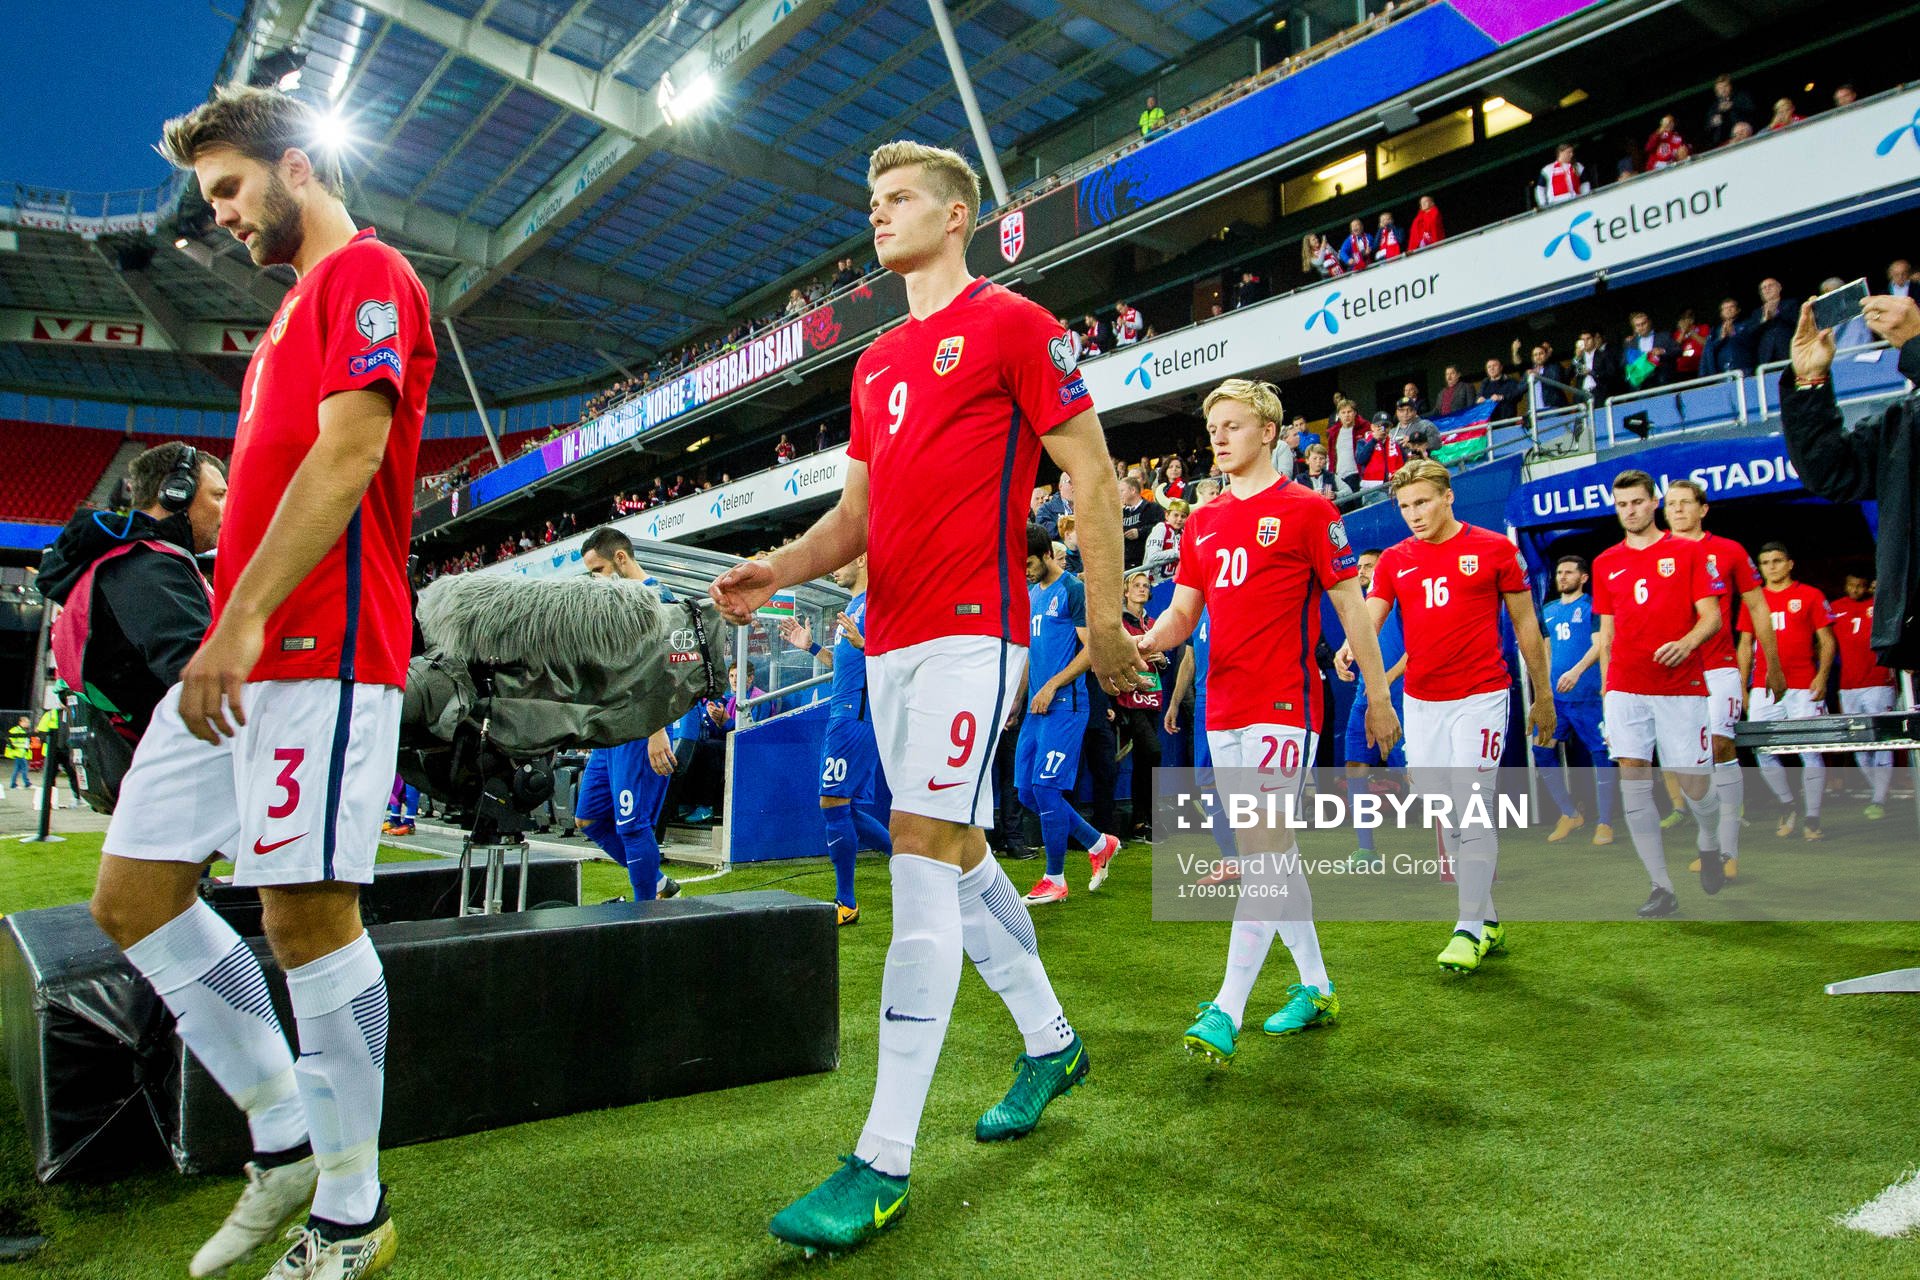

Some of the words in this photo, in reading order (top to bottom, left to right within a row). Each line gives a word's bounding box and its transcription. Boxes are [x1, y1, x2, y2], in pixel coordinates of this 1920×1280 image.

[1594, 182, 1729, 245] telenor
[1342, 273, 1440, 320] telenor
[38, 318, 141, 344] VG
[1154, 338, 1228, 378] telenor
[888, 381, 908, 435] 9
[799, 465, 837, 487] telenor
[722, 491, 754, 512] telenor
[658, 512, 685, 532] telenor
[1215, 547, 1249, 589] 20
[1422, 576, 1450, 609] 16
[1634, 578, 1649, 605] 6
[1031, 614, 1043, 637] 17
[1555, 622, 1571, 640] 16
[1770, 611, 1786, 631] 11
[947, 711, 977, 768] 9
[1480, 728, 1501, 761] 16
[1700, 726, 1709, 751] 6
[822, 757, 848, 783] 20
[1046, 750, 1066, 774] 17
[1258, 735, 1300, 779] 20
[267, 748, 305, 819] 3
[619, 789, 634, 817] 9
